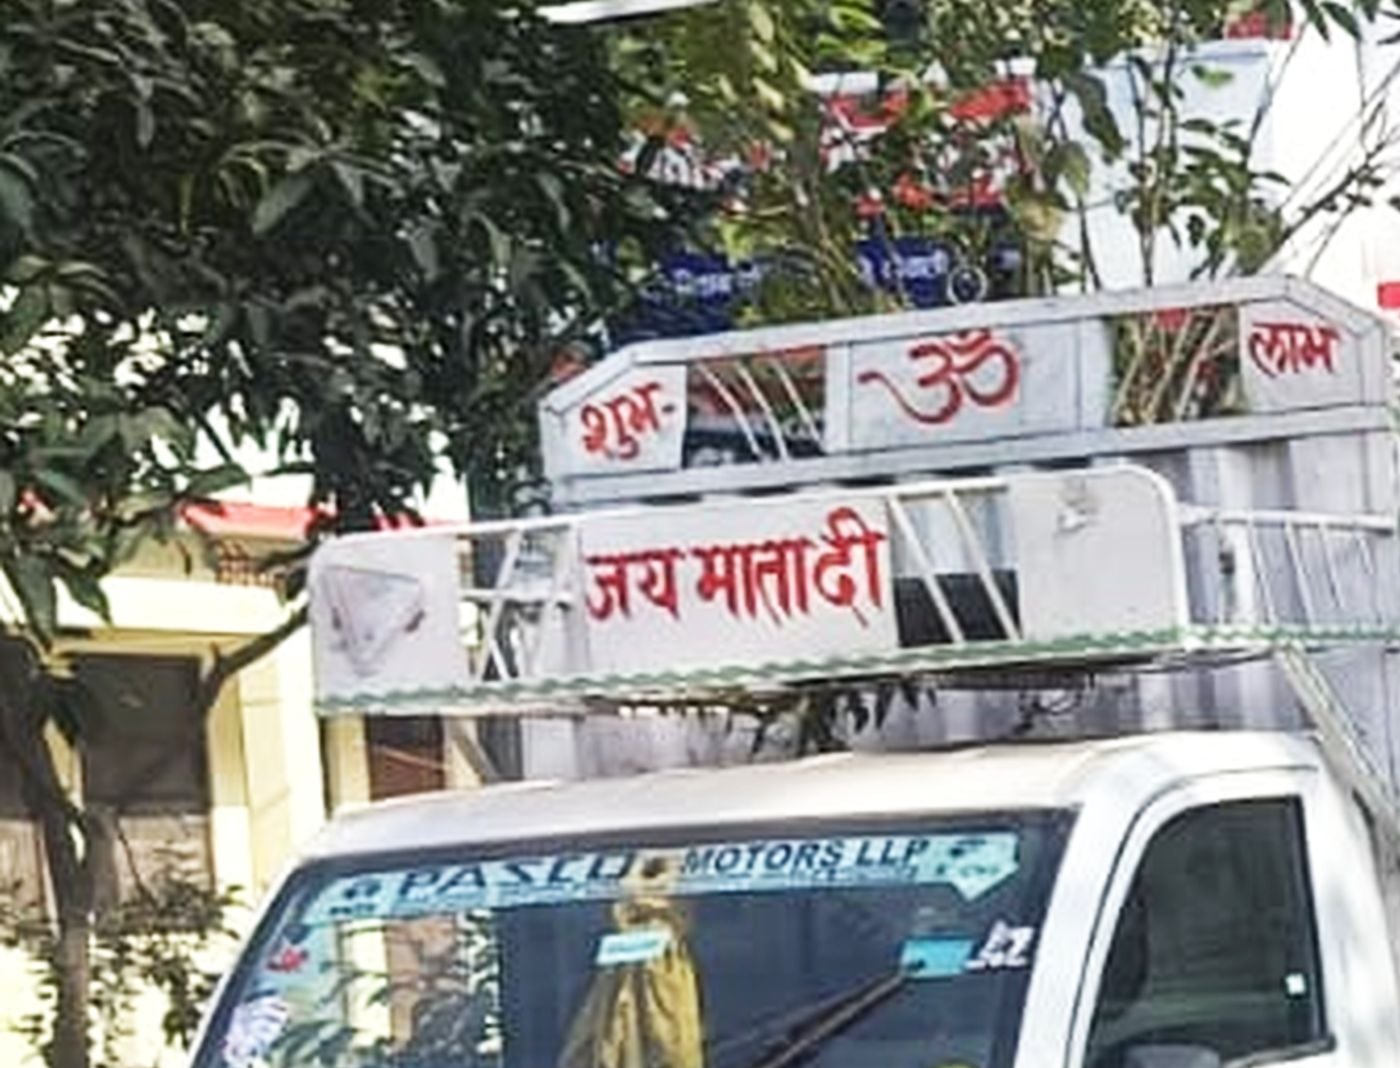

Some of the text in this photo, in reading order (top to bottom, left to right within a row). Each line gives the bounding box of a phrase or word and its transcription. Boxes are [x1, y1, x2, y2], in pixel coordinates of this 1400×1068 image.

[1246, 321, 1338, 377] लाभ
[585, 549, 685, 620] जय
[680, 841, 843, 874] MOTORS
[854, 838, 929, 870] LLP
